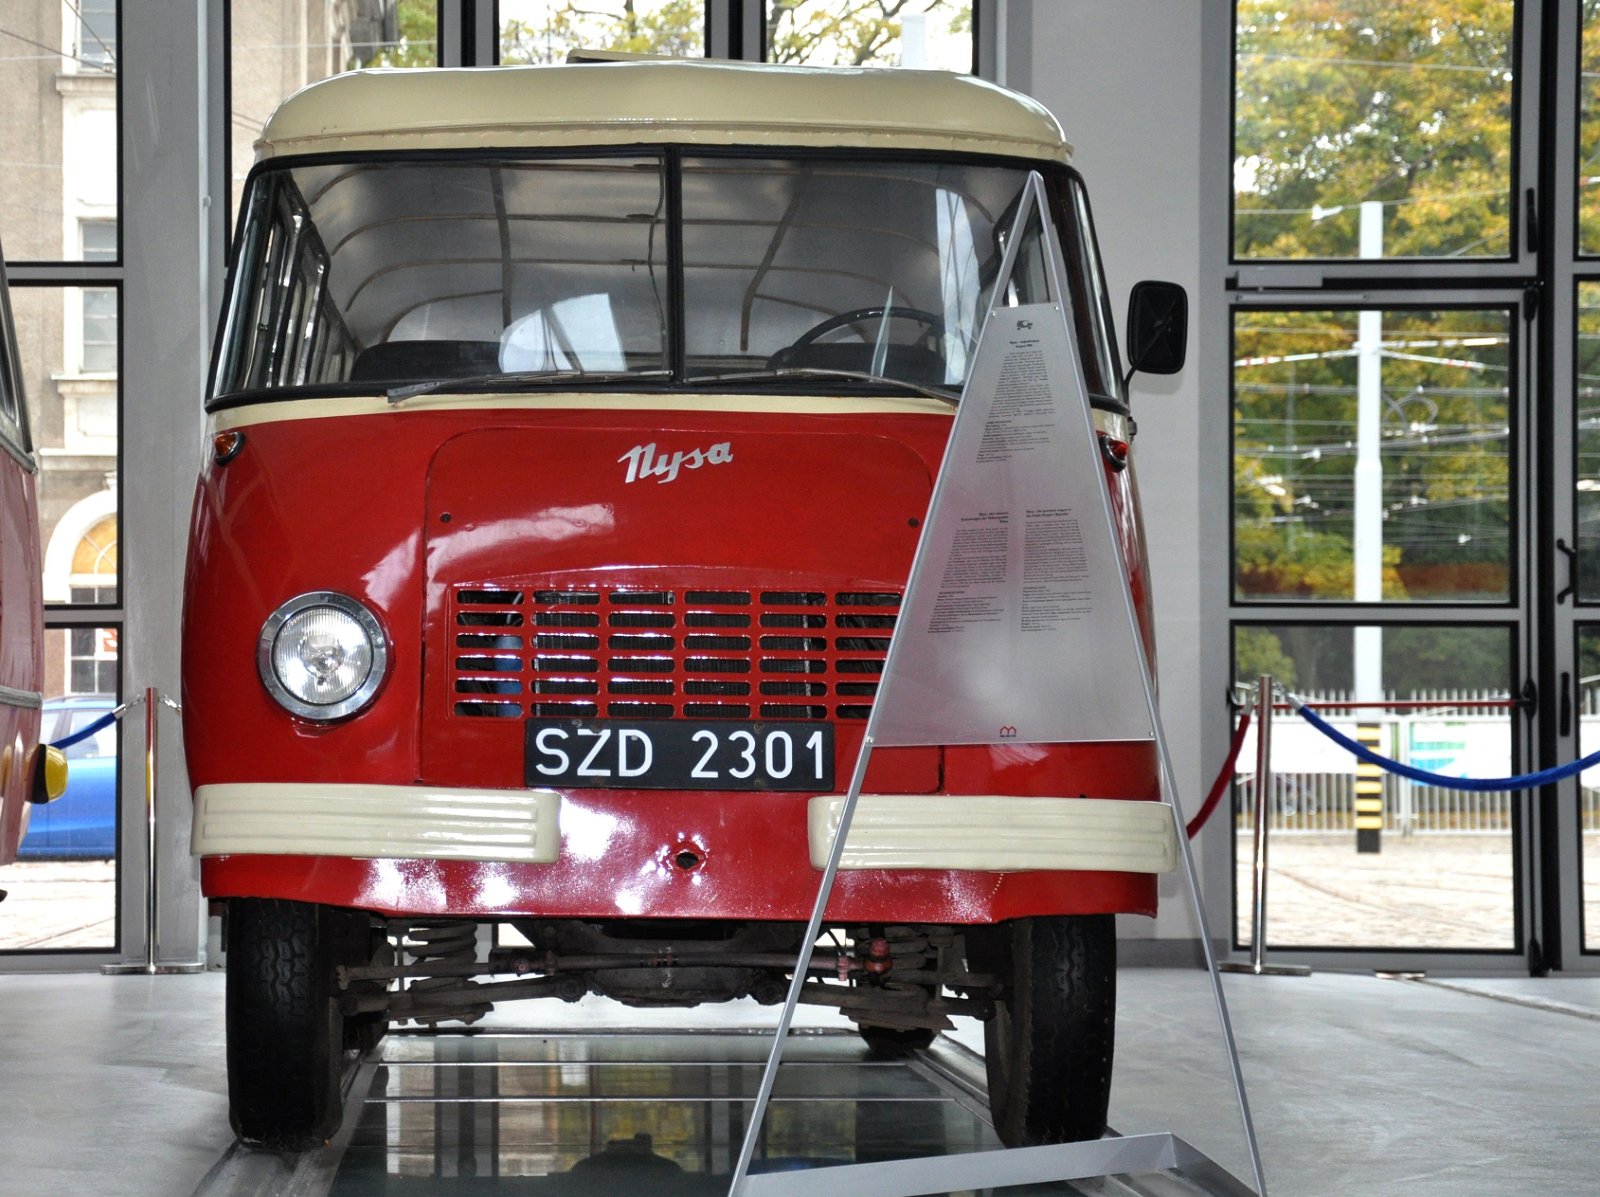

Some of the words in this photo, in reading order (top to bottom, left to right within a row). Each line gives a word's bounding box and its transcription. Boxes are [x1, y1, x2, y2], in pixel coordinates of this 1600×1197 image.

[617, 442, 734, 484] Nysa
[535, 728, 653, 777] SZD
[690, 730, 823, 779] 2301
